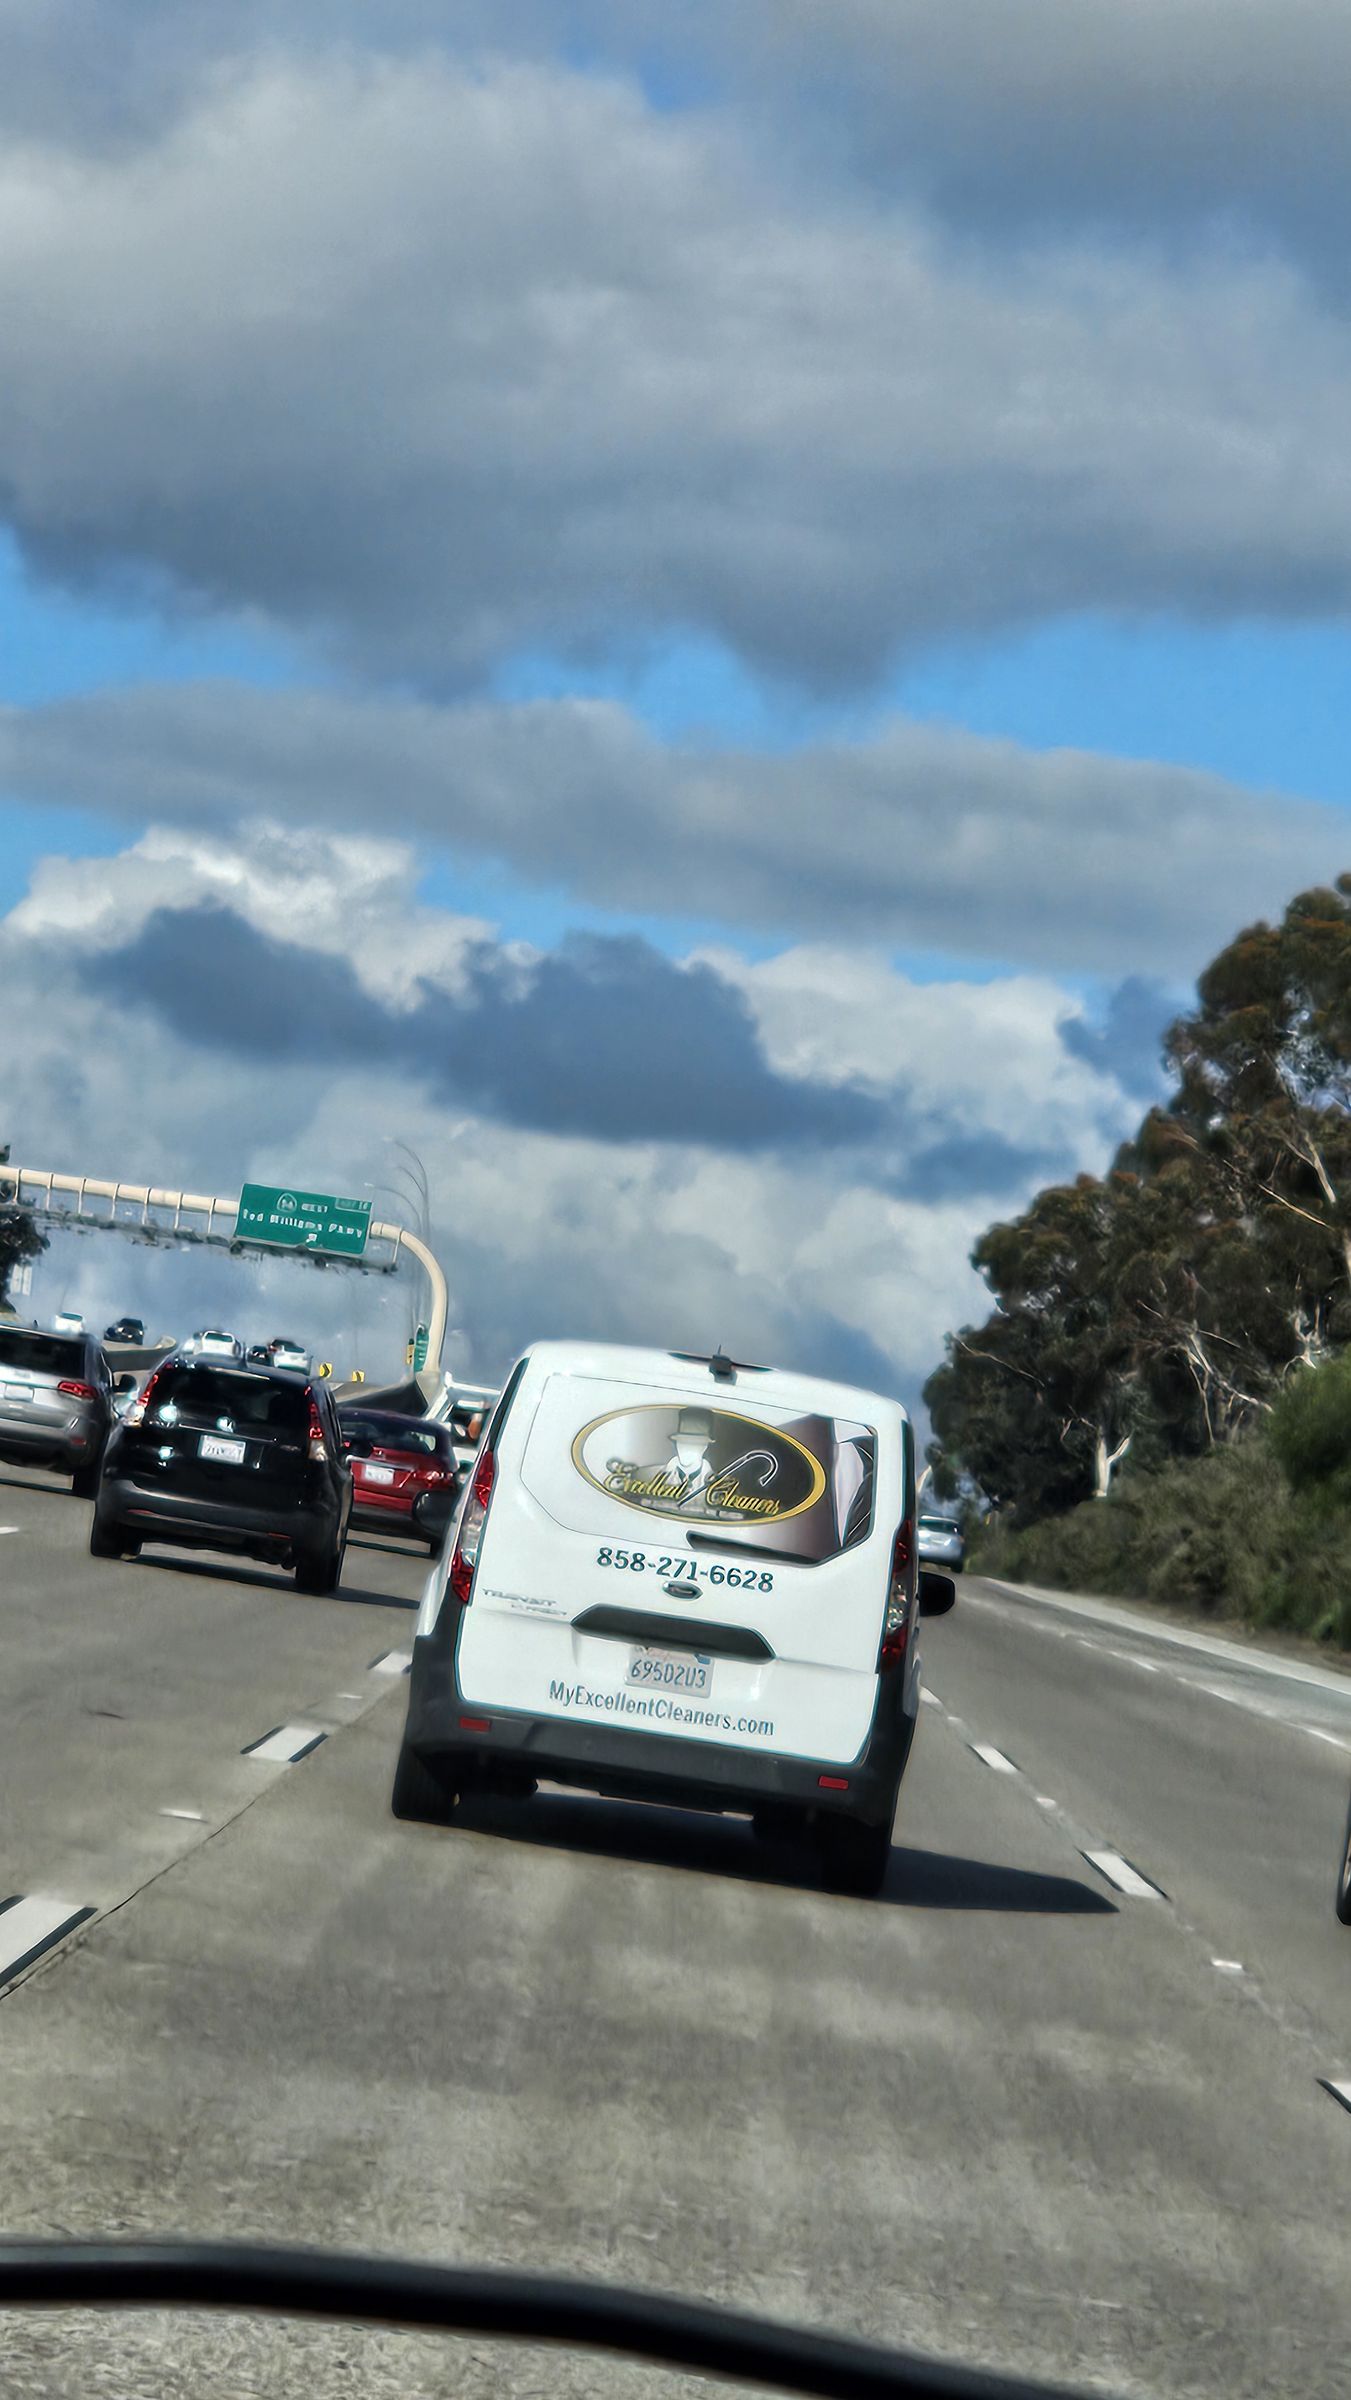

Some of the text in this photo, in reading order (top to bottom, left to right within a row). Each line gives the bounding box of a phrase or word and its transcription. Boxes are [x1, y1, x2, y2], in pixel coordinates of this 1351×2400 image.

[604, 1461, 688, 1500] Excellent
[706, 1474, 781, 1515] Cleaners
[596, 1547, 774, 1594] 858-271-6628
[549, 1679, 775, 1736] MyExcellentCleaners.com
